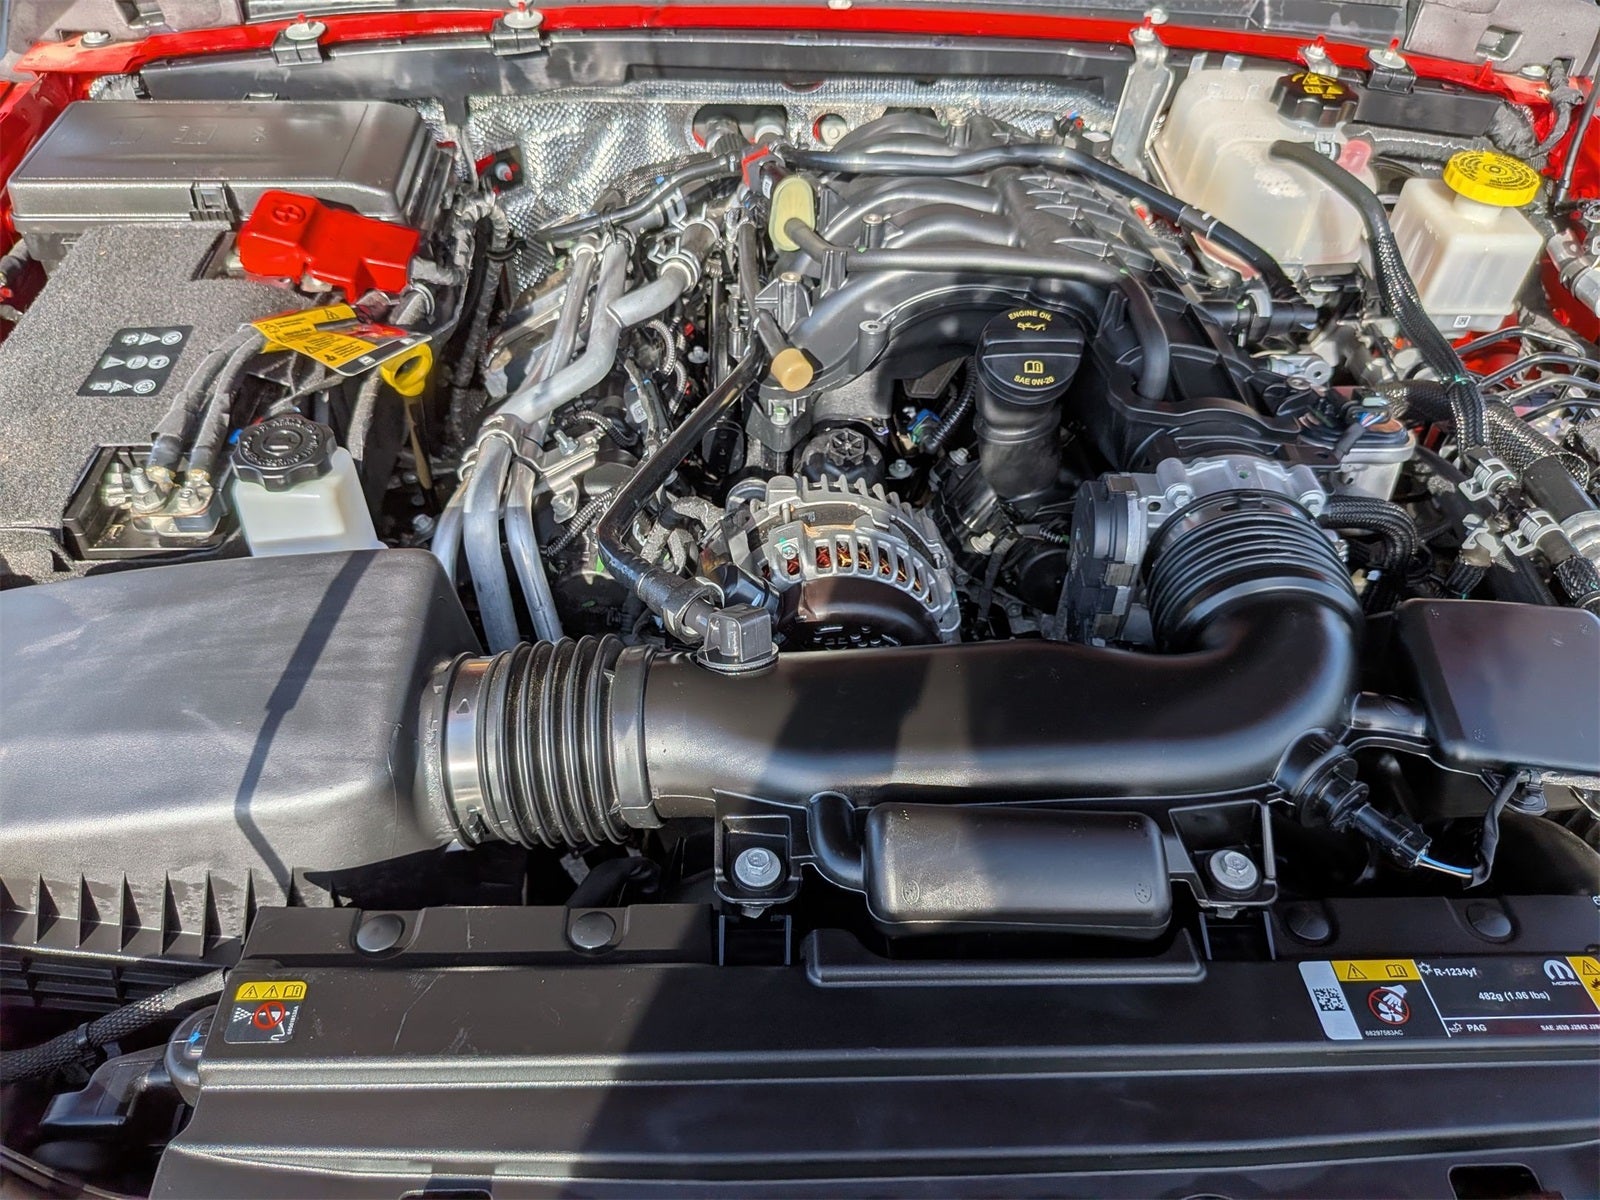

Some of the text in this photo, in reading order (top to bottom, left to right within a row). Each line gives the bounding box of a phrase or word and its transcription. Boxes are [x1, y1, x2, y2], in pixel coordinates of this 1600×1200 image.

[1008, 310, 1053, 321] ENGINE OIL
[1014, 375, 1055, 385] SAE 0W-20
[1433, 966, 1477, 978] R-1234yf
[1479, 990, 1550, 1002] 482g (1.06 lbs)
[1467, 1023, 1487, 1032] PAG
